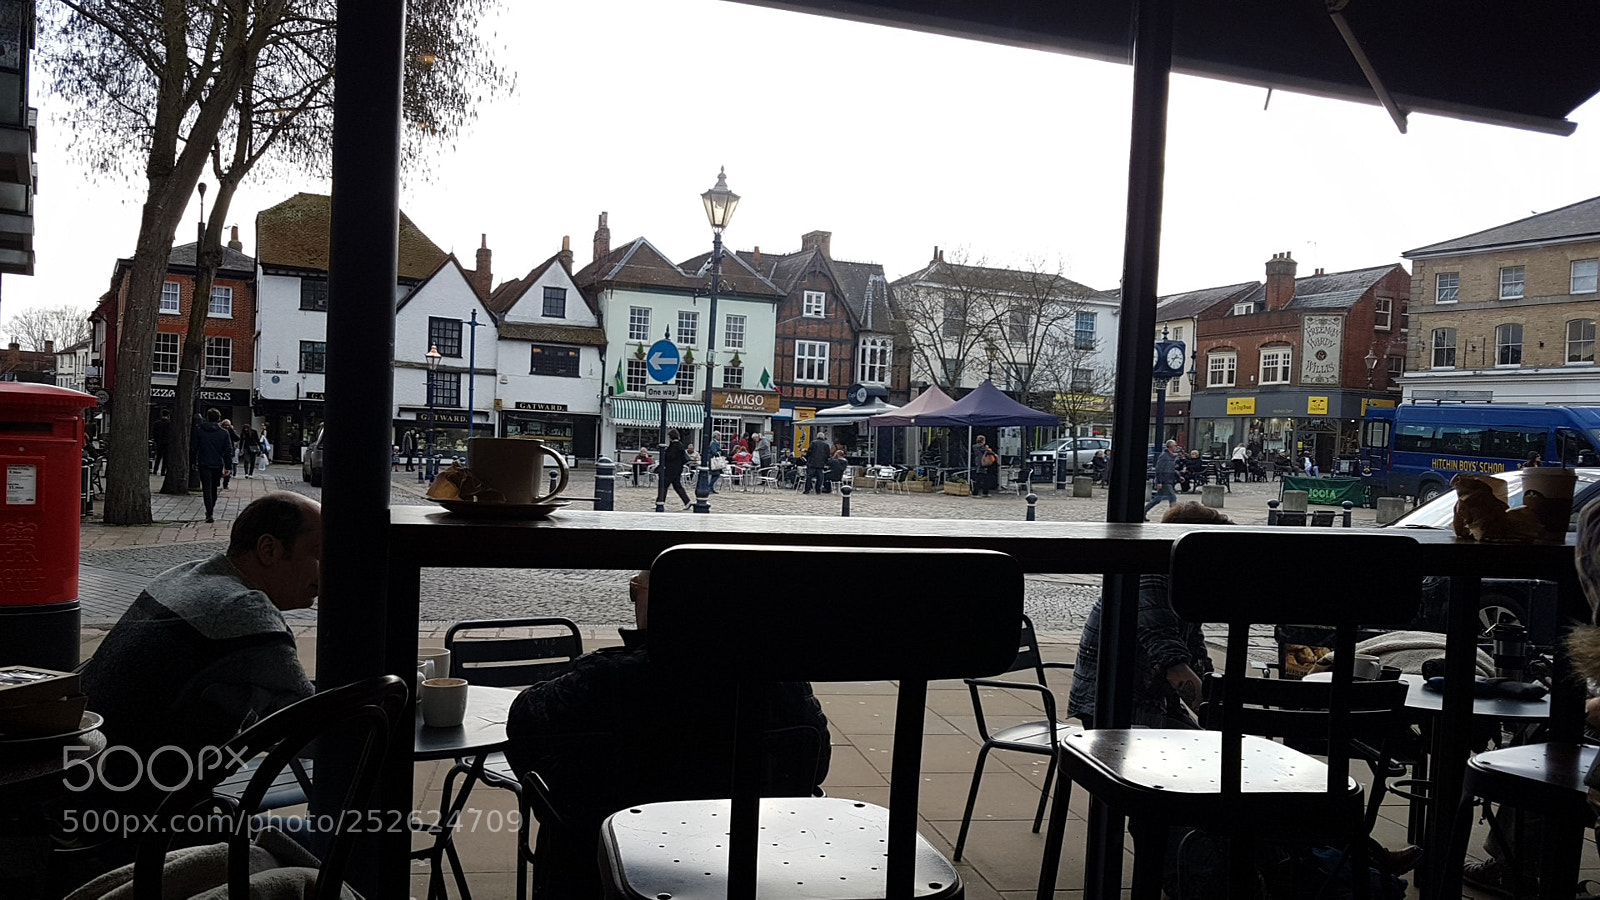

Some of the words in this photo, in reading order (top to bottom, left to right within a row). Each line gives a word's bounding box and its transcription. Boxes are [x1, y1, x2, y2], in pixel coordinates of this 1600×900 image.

[1305, 326, 1340, 338] FREEMAN
[1307, 337, 1336, 349] HARDY
[1305, 360, 1335, 374] WILLIS
[150, 388, 176, 398] IZZA
[199, 391, 231, 401] RESS
[648, 388, 661, 396] One
[662, 389, 676, 397] way
[725, 393, 764, 406] AMIGO
[420, 414, 468, 423] GTWARD.
[1431, 458, 1459, 470] HITCHIN
[1459, 460, 1479, 472] BOYS'
[1479, 461, 1505, 474] SCHOOL
[1308, 488, 1336, 499] JOOLA
